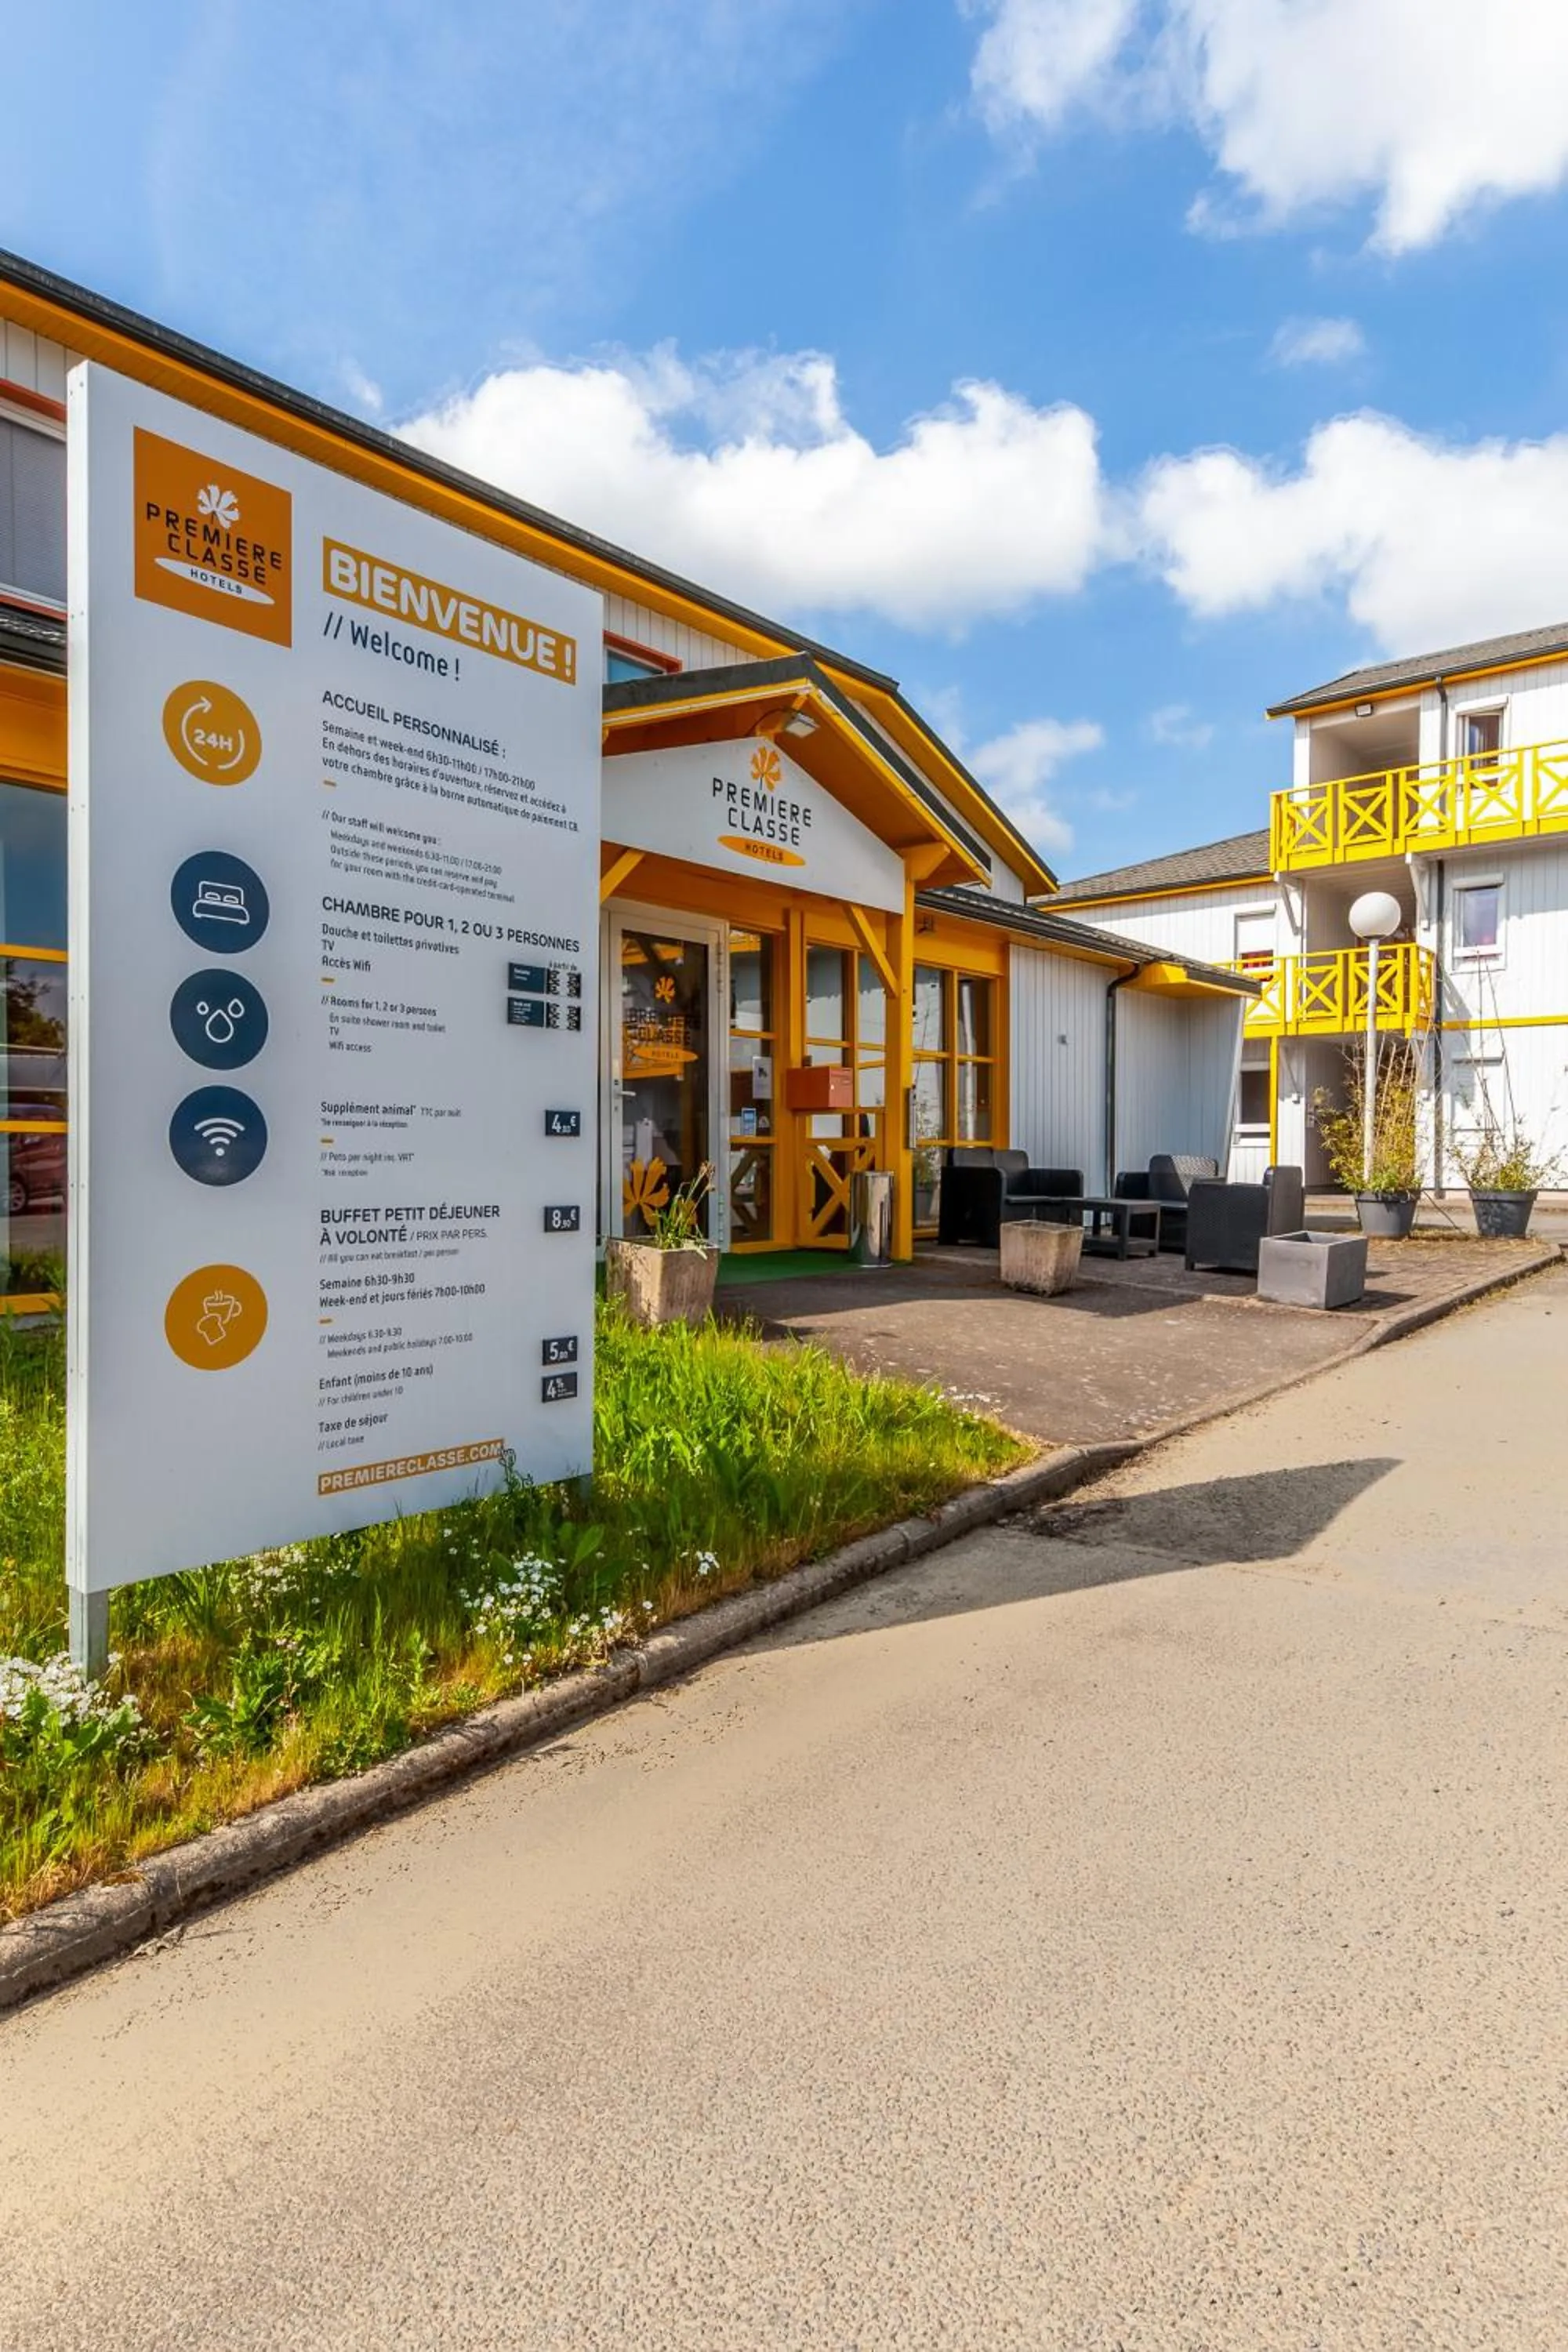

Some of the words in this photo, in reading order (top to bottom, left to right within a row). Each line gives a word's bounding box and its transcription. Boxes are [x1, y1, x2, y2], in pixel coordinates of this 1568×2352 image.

[146, 501, 281, 571] PREMIERE
[167, 532, 266, 586] CLASSE
[190, 568, 242, 595] HOTELS
[328, 547, 556, 672] BIENVENUE
[350, 619, 448, 676] Welcome
[322, 690, 389, 723] ACCUEIL
[393, 711, 499, 756] PERSONNALISÉ
[194, 728, 232, 752] 24H
[322, 720, 365, 742] Semaine
[367, 735, 377, 746] et
[379, 739, 424, 759] week-end
[322, 736, 334, 750] En
[336, 741, 370, 760] dehors
[372, 751, 390, 765] des
[391, 755, 430, 776] horaires
[484, 783, 518, 800] réservez
[520, 793, 528, 803] et
[322, 757, 348, 771] votre
[350, 763, 393, 782] chambre
[394, 775, 420, 790] grâce
[440, 786, 464, 801] borne
[466, 795, 519, 815] automatique
[712, 776, 812, 828] PREMIERE
[331, 811, 346, 823] Our
[347, 817, 368, 828] staff
[385, 827, 420, 840] welcome
[728, 806, 800, 846] CLASSE
[743, 843, 783, 862] HOTELS
[322, 896, 400, 922] CHAMBRE
[404, 910, 444, 929] POUR
[447, 918, 458, 933] 1,
[461, 920, 469, 934] 2
[473, 922, 492, 938] OU
[495, 926, 503, 939] 3
[507, 927, 579, 953] PERSONNES
[321, 923, 358, 939] Douche
[361, 931, 371, 941] et
[372, 931, 413, 947] toilettes
[415, 939, 459, 954] privatives
[321, 938, 334, 951] TV
[321, 954, 350, 969] Accès
[352, 960, 370, 971] Wifi
[330, 995, 359, 1008] Rooms
[361, 998, 373, 1009] for
[405, 1006, 437, 1016] persons
[329, 1025, 339, 1036] TV
[328, 1040, 343, 1050] Wifi
[321, 1101, 379, 1115] Supplément
[321, 1207, 380, 1223] BUFFET
[385, 1207, 425, 1221] PETIT
[429, 1203, 499, 1220] DÉJEUNER
[319, 1227, 331, 1245] À
[335, 1223, 407, 1244] VOLONTÉ
[416, 1230, 438, 1240] PRIX
[440, 1229, 460, 1239] PAR
[319, 1277, 361, 1290] Semaine
[364, 1272, 414, 1287] 6h30-9h30
[319, 1293, 367, 1308] Week-end
[369, 1292, 379, 1303] et
[381, 1290, 405, 1305] jours
[406, 1288, 433, 1300] fériés
[434, 1283, 485, 1298] 7h00-10h00
[319, 1375, 351, 1389] Enfant
[354, 1371, 386, 1386] (moins
[387, 1368, 400, 1380] de
[401, 1367, 412, 1377] 10
[318, 1421, 342, 1432] Taxe
[344, 1417, 357, 1428] de
[358, 1413, 387, 1427] séjour
[320, 1441, 502, 1492] PREMIERECLASSE.COM
